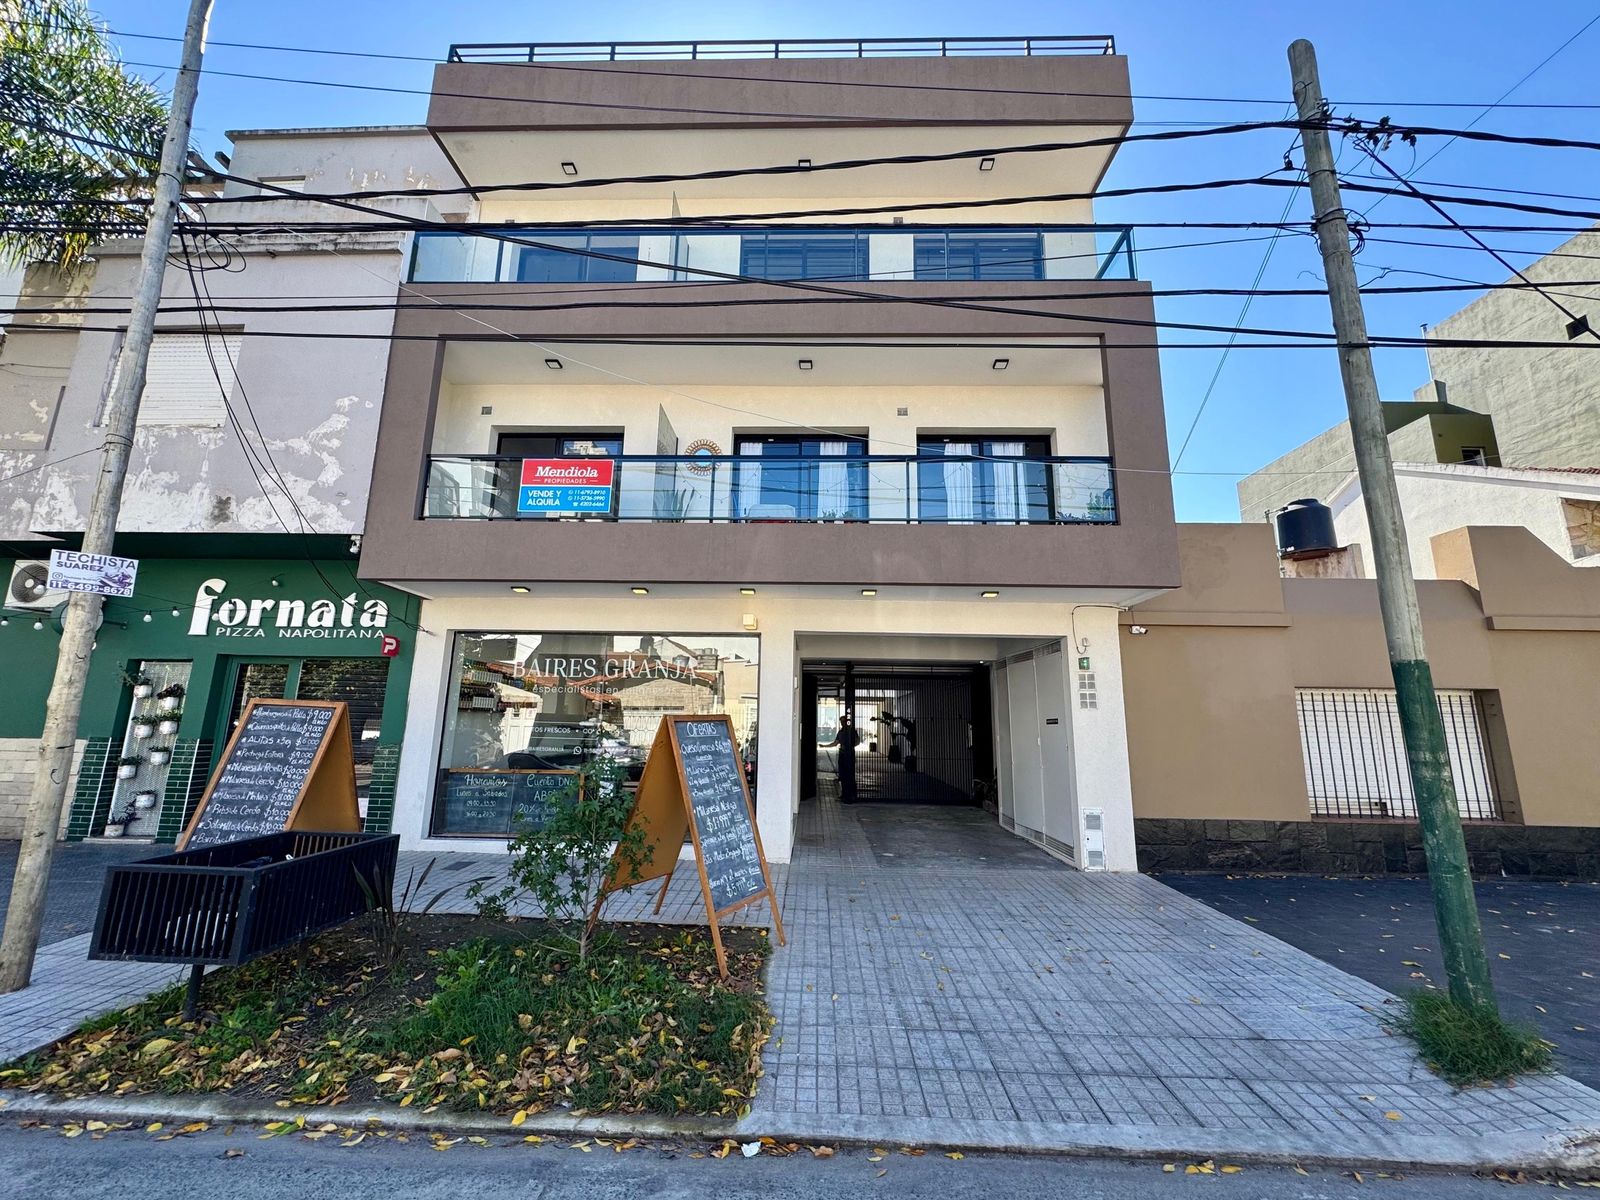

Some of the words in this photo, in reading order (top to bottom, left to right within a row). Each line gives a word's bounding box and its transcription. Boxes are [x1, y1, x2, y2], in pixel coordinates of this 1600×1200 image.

[535, 466, 598, 478] Mendiola
[528, 490, 555, 498] VENDE
[556, 490, 562, 498] Y
[526, 498, 561, 506] ALQUILA
[55, 550, 136, 570] TECHISTA
[56, 560, 104, 573] SUAREZ
[51, 580, 131, 595] 11-6499-8678
[187, 578, 389, 636] fornata
[216, 627, 265, 638] PIZZA
[279, 628, 385, 639] NAPOLITANA
[513, 658, 597, 678] BAIRES
[604, 658, 699, 679] GRANJA
[532, 685, 601, 695] especialistas
[606, 686, 619, 694] en
[464, 774, 508, 787] Horarios
